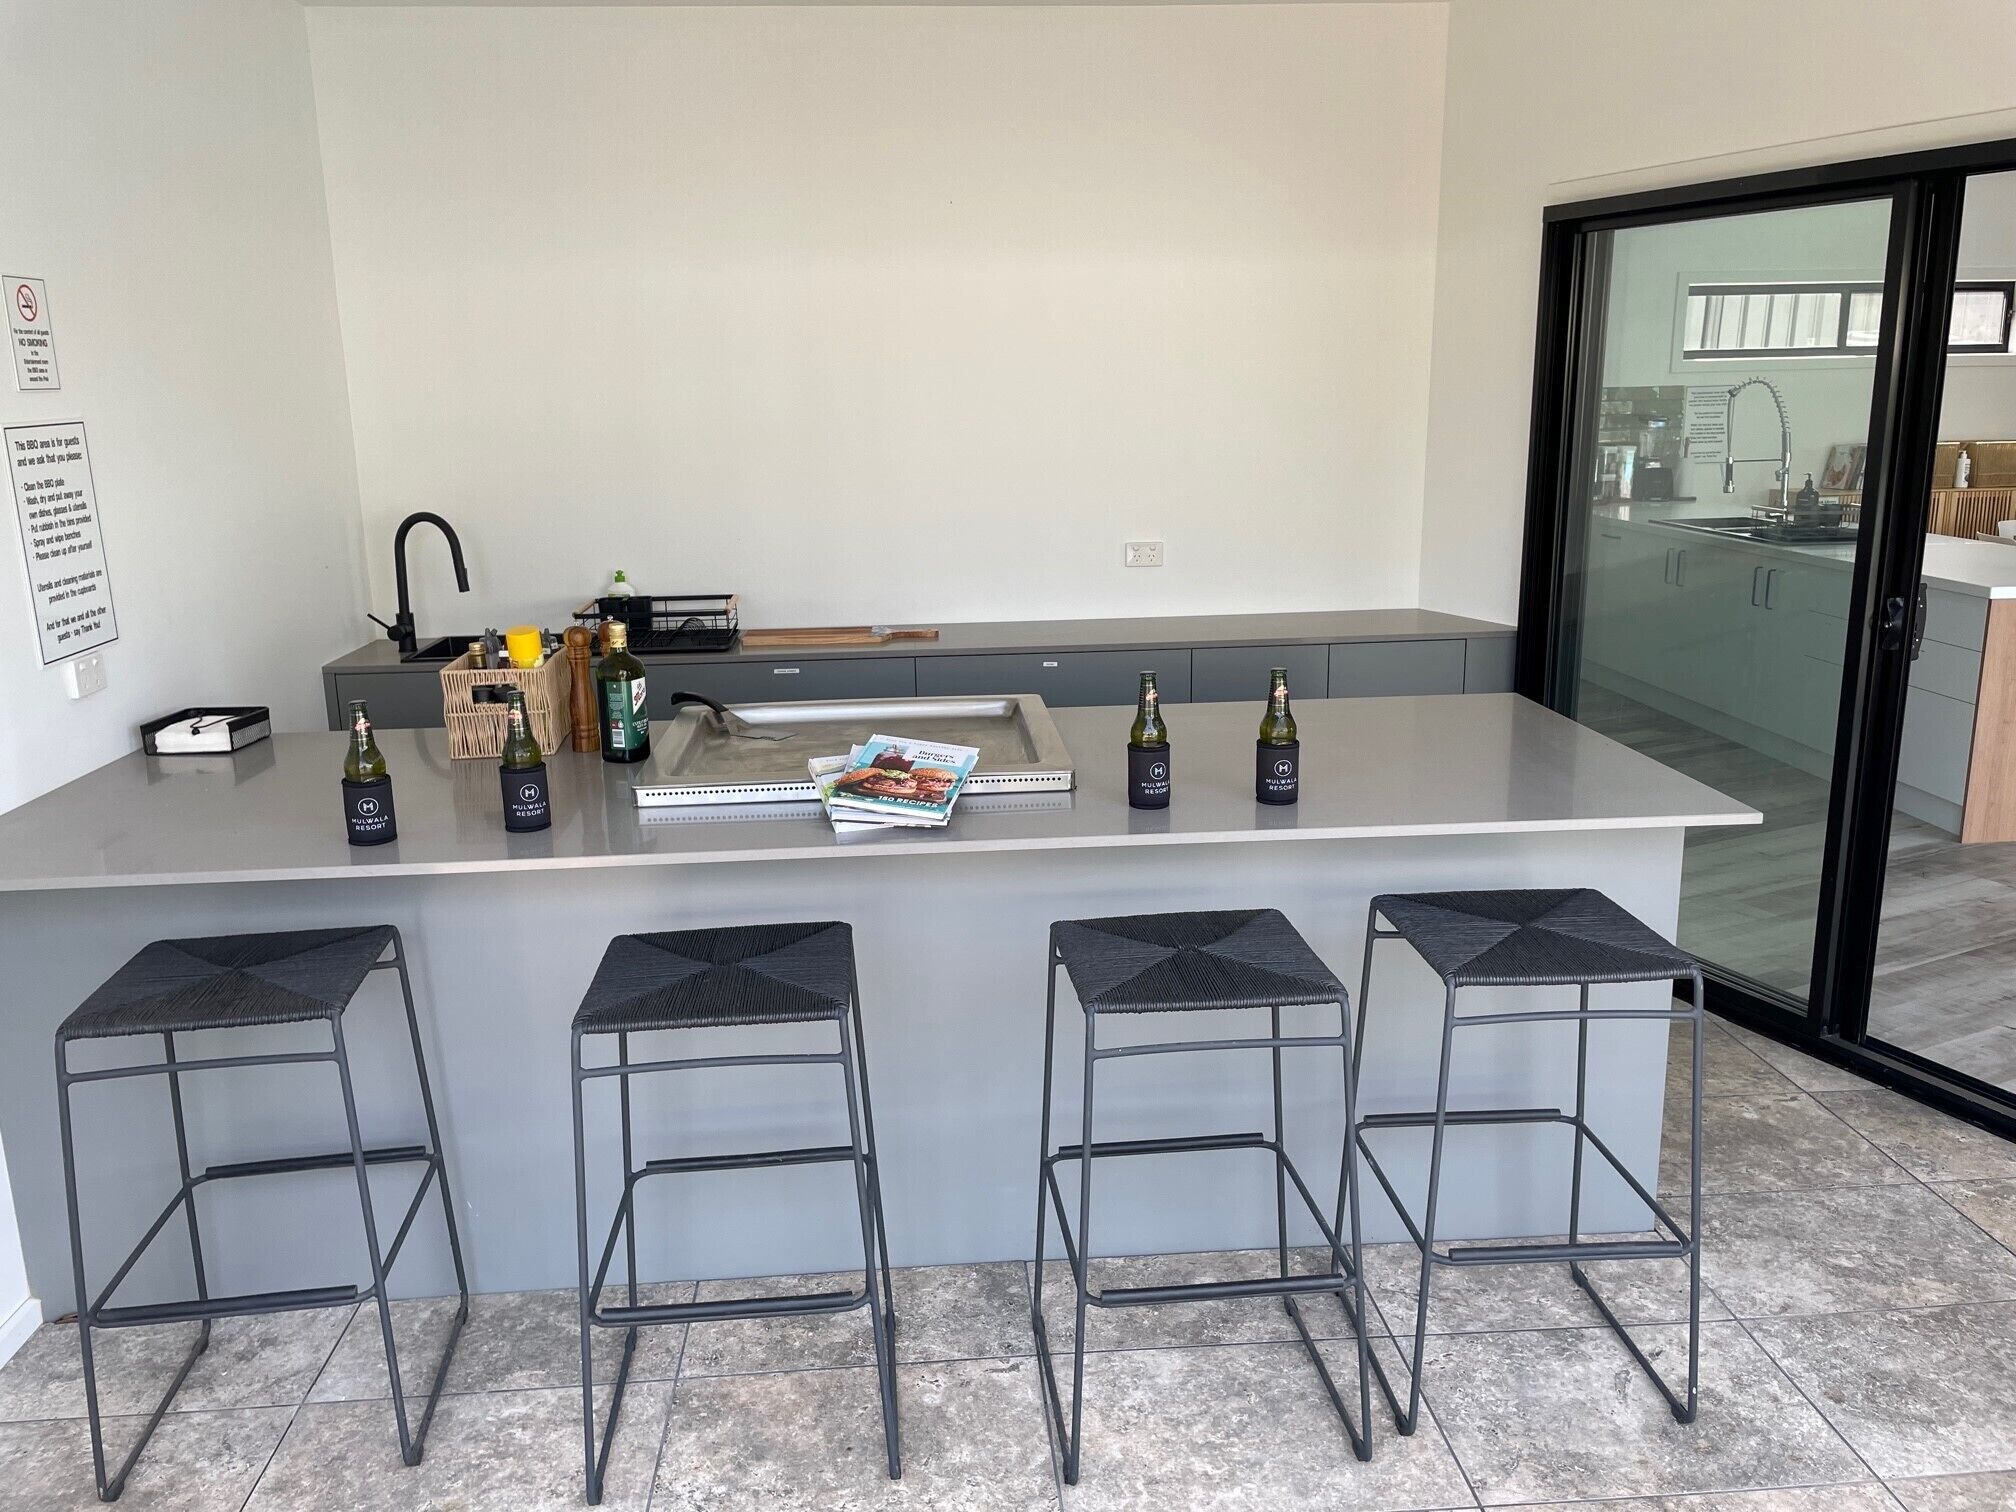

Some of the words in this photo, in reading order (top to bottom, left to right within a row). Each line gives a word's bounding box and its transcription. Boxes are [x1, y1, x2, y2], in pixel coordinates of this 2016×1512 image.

[18, 338, 26, 346] NO
[27, 338, 48, 347] SMOKING
[15, 440, 26, 450] This
[26, 439, 39, 449] BBQ
[39, 440, 51, 448] area
[51, 438, 56, 447] is
[63, 436, 80, 448] guests
[17, 456, 28, 466] and
[36, 454, 45, 464] ask
[45, 452, 56, 463] that
[56, 454, 66, 464] you
[23, 482, 36, 491] Clean
[36, 480, 44, 489] the
[44, 479, 54, 488] BBQ
[54, 476, 65, 488] plate
[47, 492, 55, 501] and
[63, 491, 74, 499] away
[45, 535, 55, 544] and
[918, 749, 955, 760] Burgers
[932, 756, 957, 765] Sides
[1265, 777, 1297, 785] MULWALA
[1144, 786, 1169, 795] RESORT
[1268, 783, 1295, 791] RESORT
[512, 801, 547, 811] MULWALA
[896, 797, 939, 808] RECIPES
[516, 808, 545, 817] RESORT
[351, 815, 389, 825] MULWALA
[355, 822, 386, 831] RESORT
